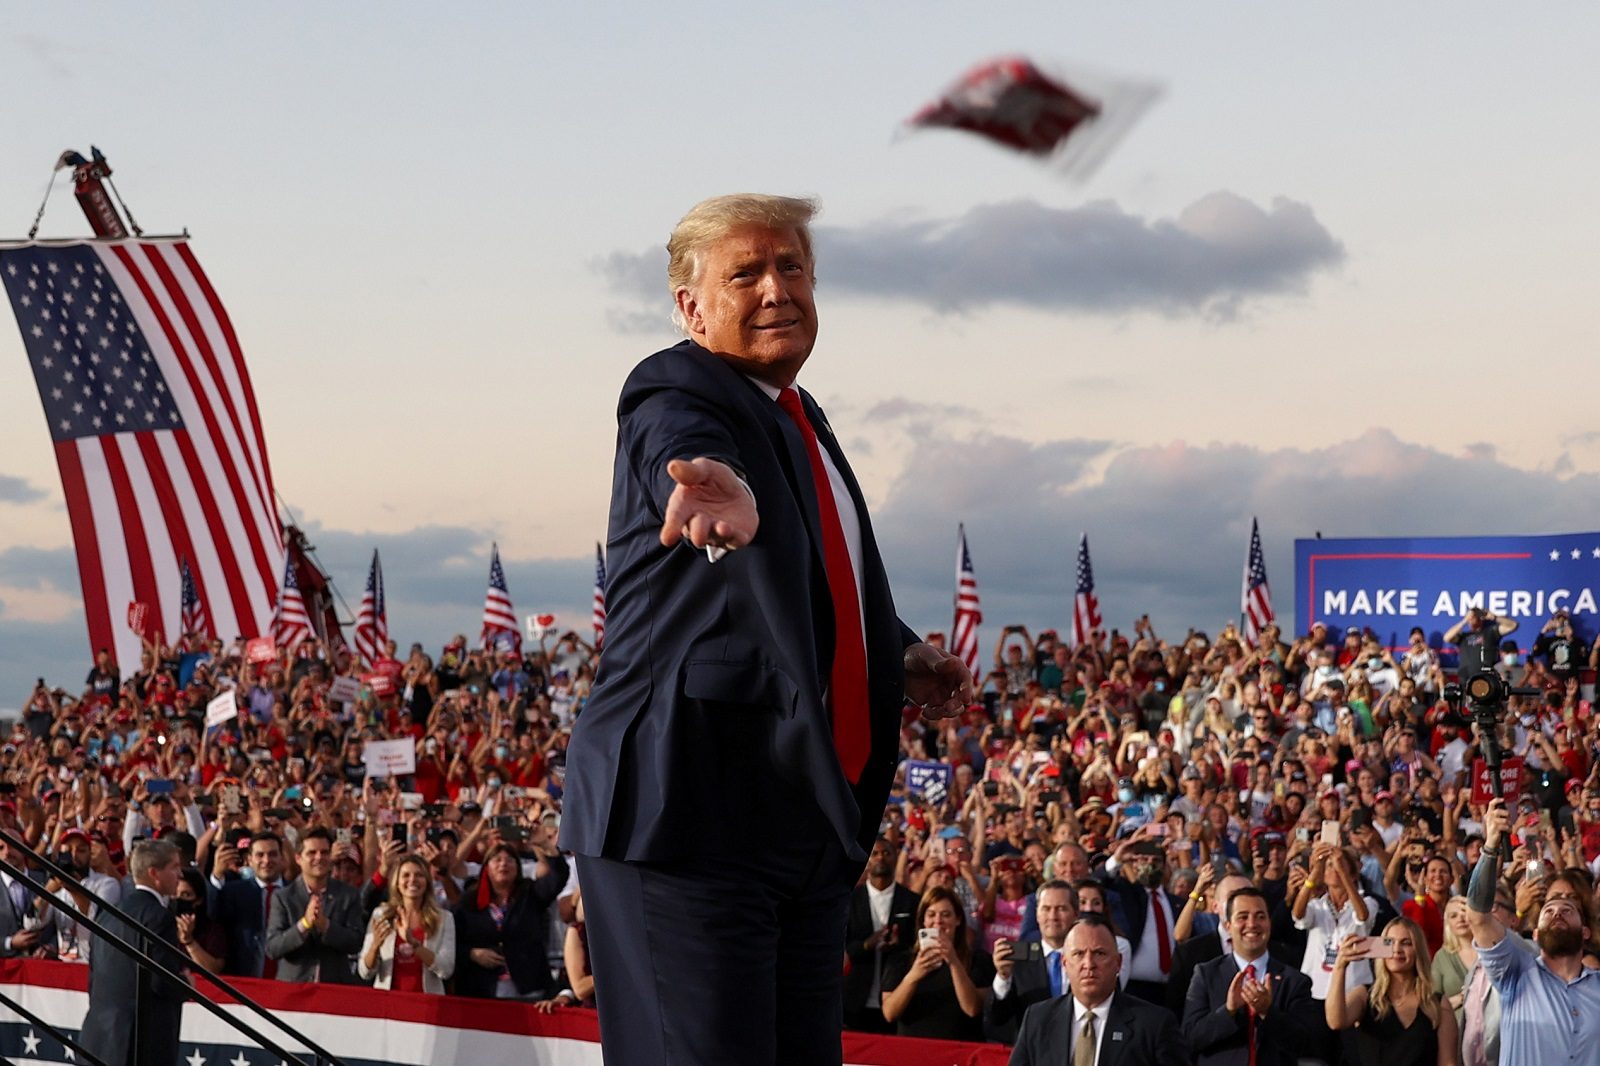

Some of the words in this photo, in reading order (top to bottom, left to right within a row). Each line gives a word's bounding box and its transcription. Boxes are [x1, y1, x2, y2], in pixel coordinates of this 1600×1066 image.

[1323, 589, 1419, 615] MAKE
[1431, 587, 1598, 616] AMERICA
[1480, 781, 1517, 794] YRS!
